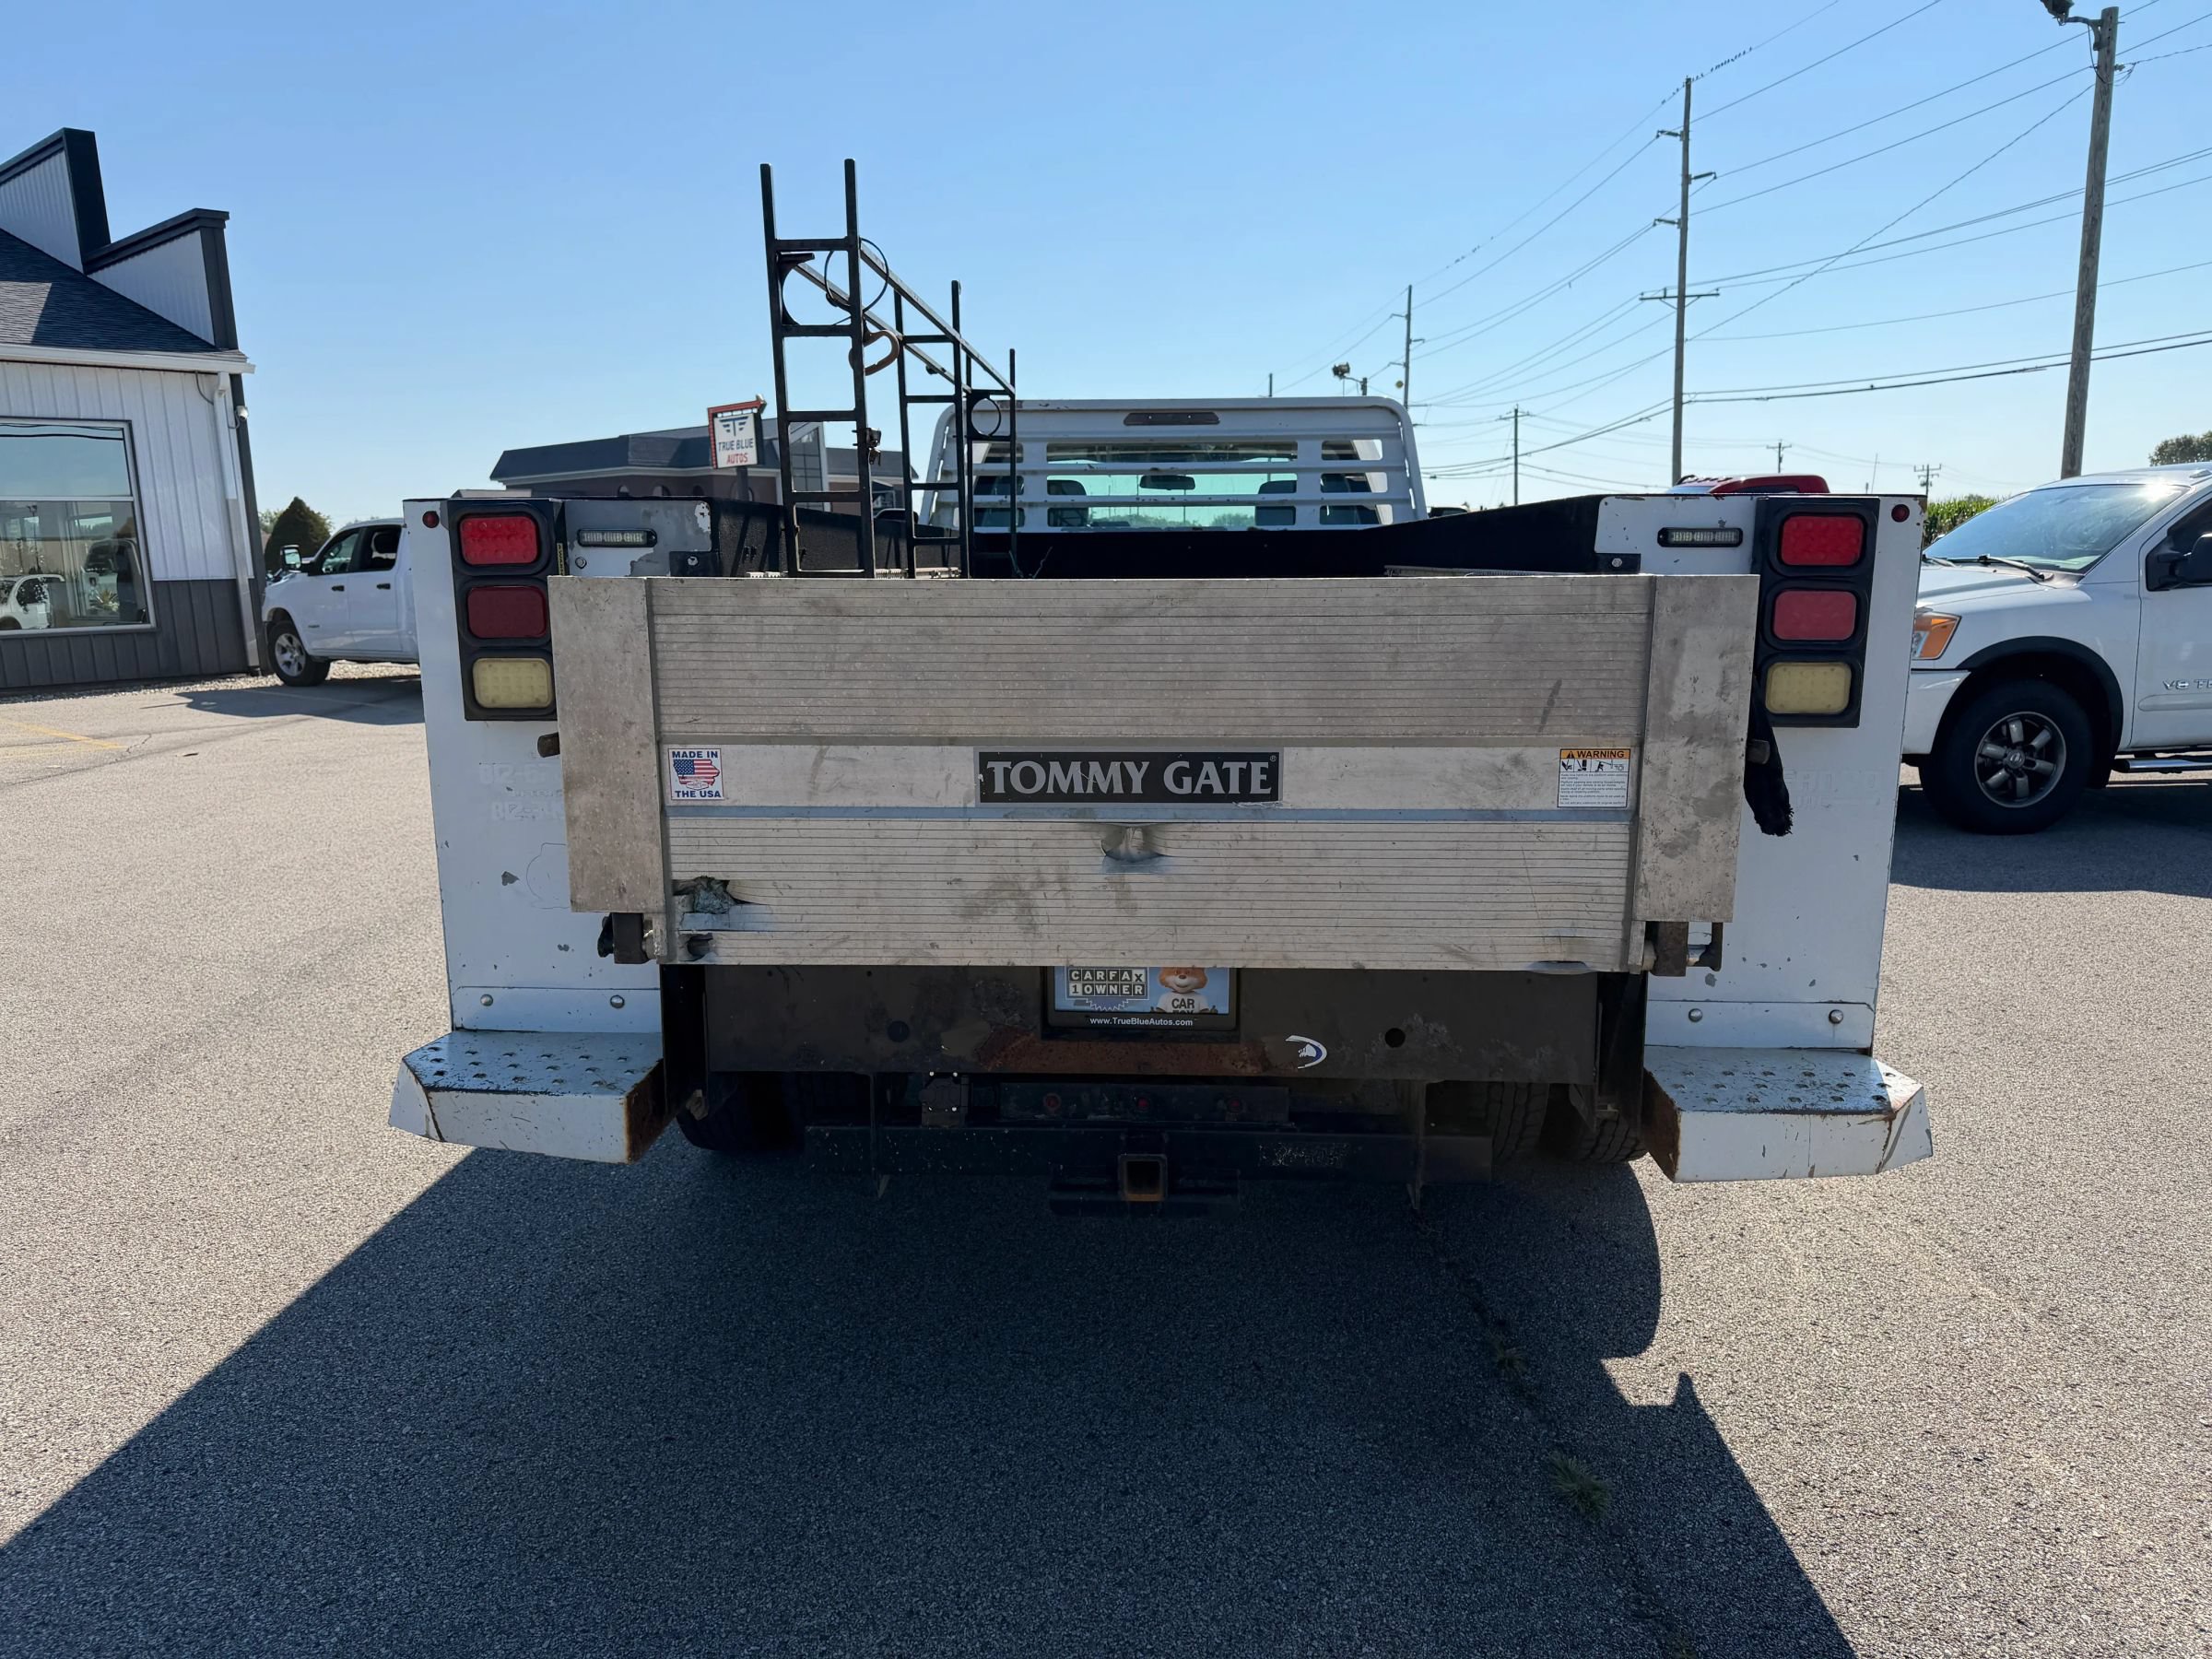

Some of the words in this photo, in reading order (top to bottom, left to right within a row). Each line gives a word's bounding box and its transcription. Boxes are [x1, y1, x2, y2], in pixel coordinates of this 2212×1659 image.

[718, 441, 735, 452] TRUE
[736, 439, 754, 450] BLUE
[726, 453, 748, 465] AUTOS
[1577, 750, 1625, 759] WARNING
[987, 760, 1150, 794] TOMMY
[675, 790, 697, 798] THE
[700, 790, 722, 798] USA
[1070, 970, 1145, 982] CARFAX
[1171, 998, 1195, 1009] CAR
[1089, 1017, 1194, 1027] www.TrueBlueAutos.com
